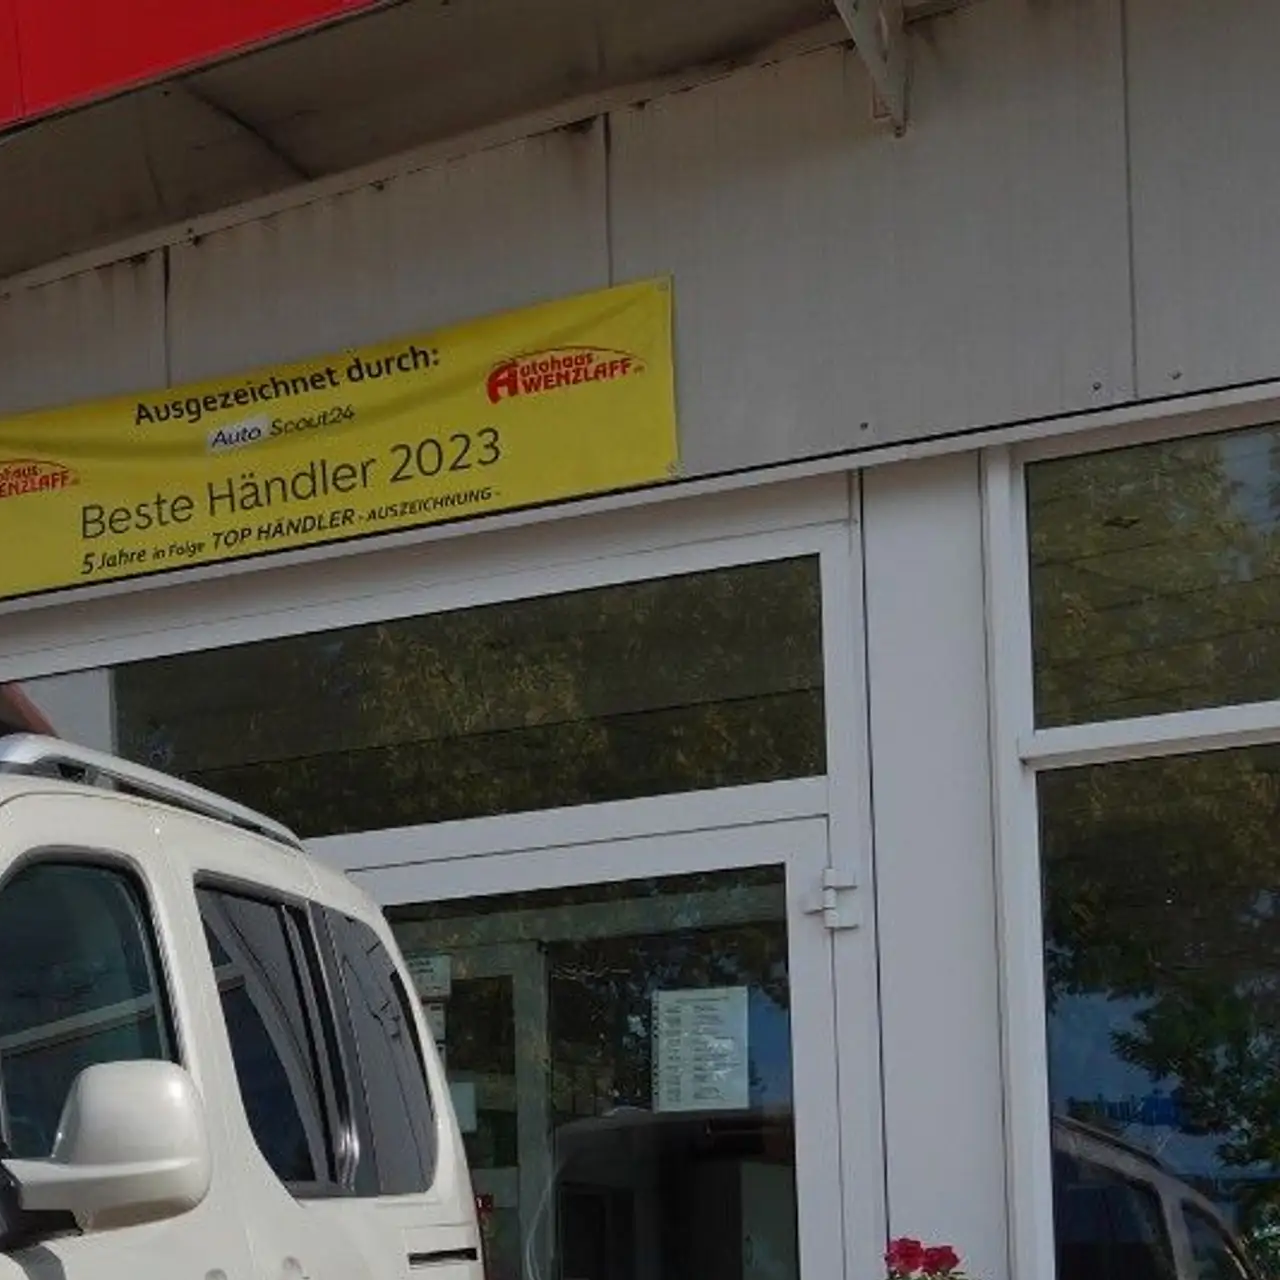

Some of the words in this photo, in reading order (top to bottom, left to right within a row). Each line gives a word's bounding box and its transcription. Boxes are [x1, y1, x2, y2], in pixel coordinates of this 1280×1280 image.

[134, 366, 340, 425] Ausgezeichnet
[347, 345, 440, 383] durch:
[522, 358, 632, 395] WENZLAFF
[211, 425, 262, 449] Auto
[81, 493, 194, 540] Beste
[207, 457, 377, 517] Händler
[389, 427, 502, 483] 2023
[81, 552, 96, 575] 5
[97, 548, 146, 570] Jahre
[152, 546, 166, 560] in
[168, 541, 206, 560] Folge
[212, 527, 252, 550] TOP
[256, 509, 355, 543] HÄNDLER
